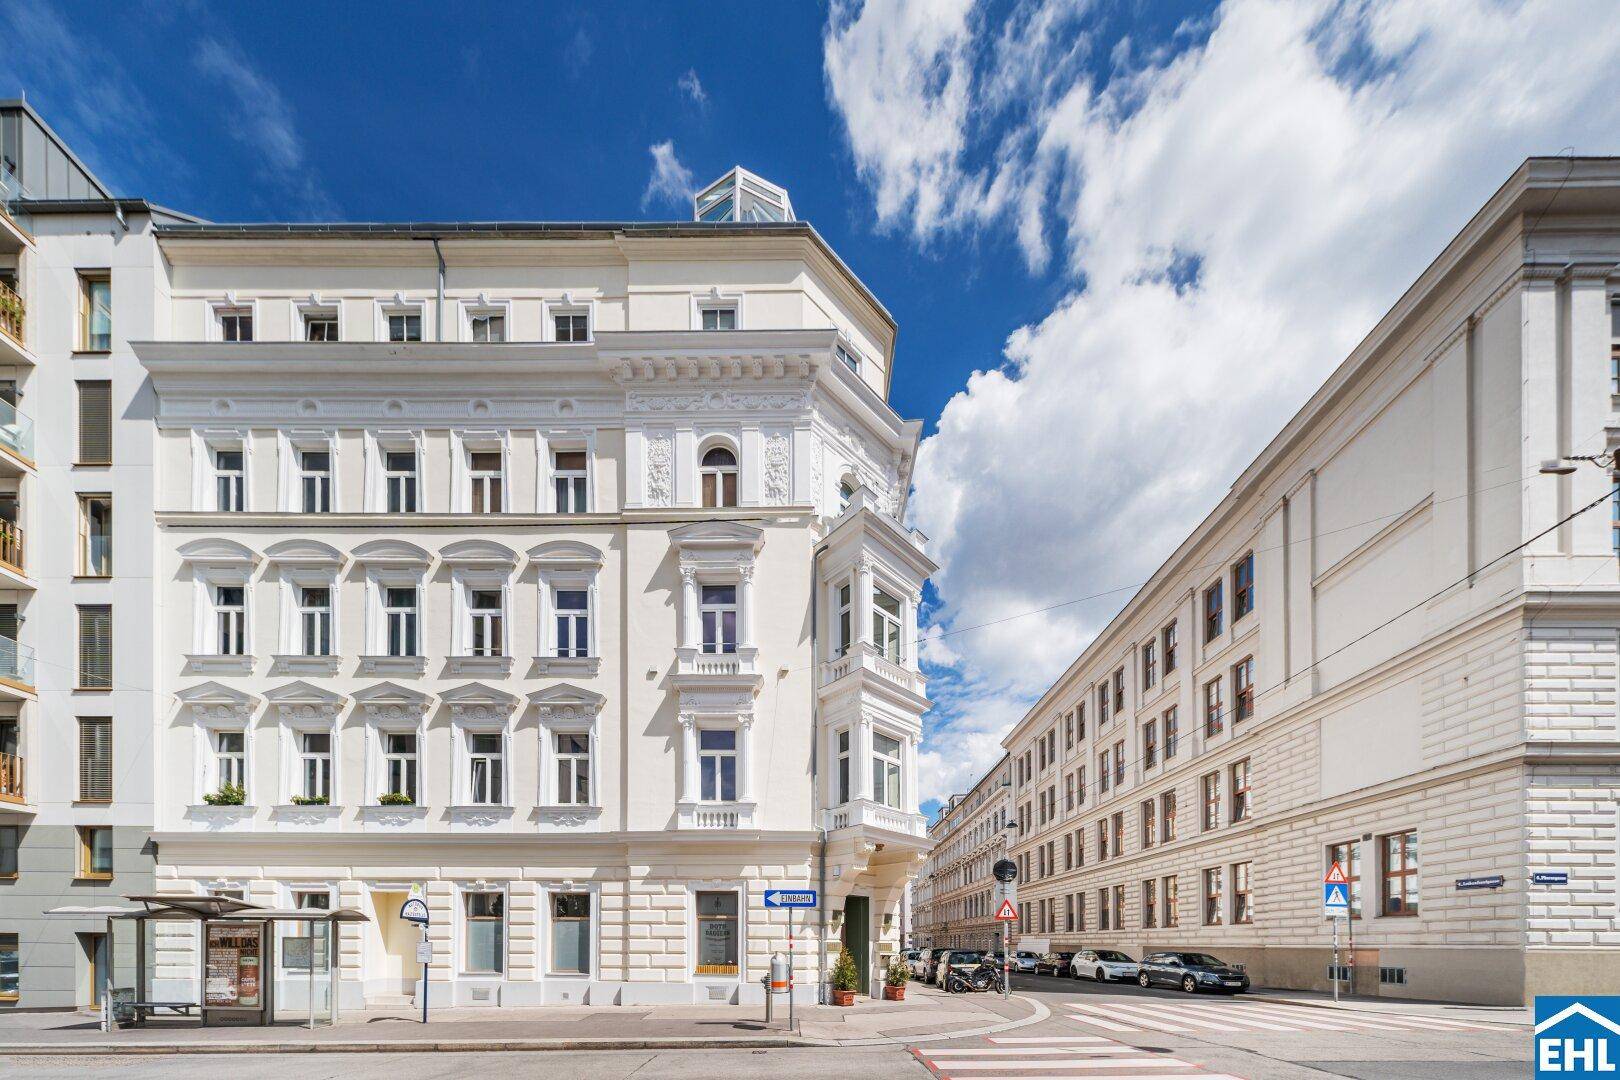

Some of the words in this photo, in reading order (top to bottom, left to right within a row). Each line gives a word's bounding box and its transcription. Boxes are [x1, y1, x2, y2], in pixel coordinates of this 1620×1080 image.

[781, 894, 811, 903] EINBAHN
[220, 936, 240, 948] WILL
[241, 936, 259, 948] DAS
